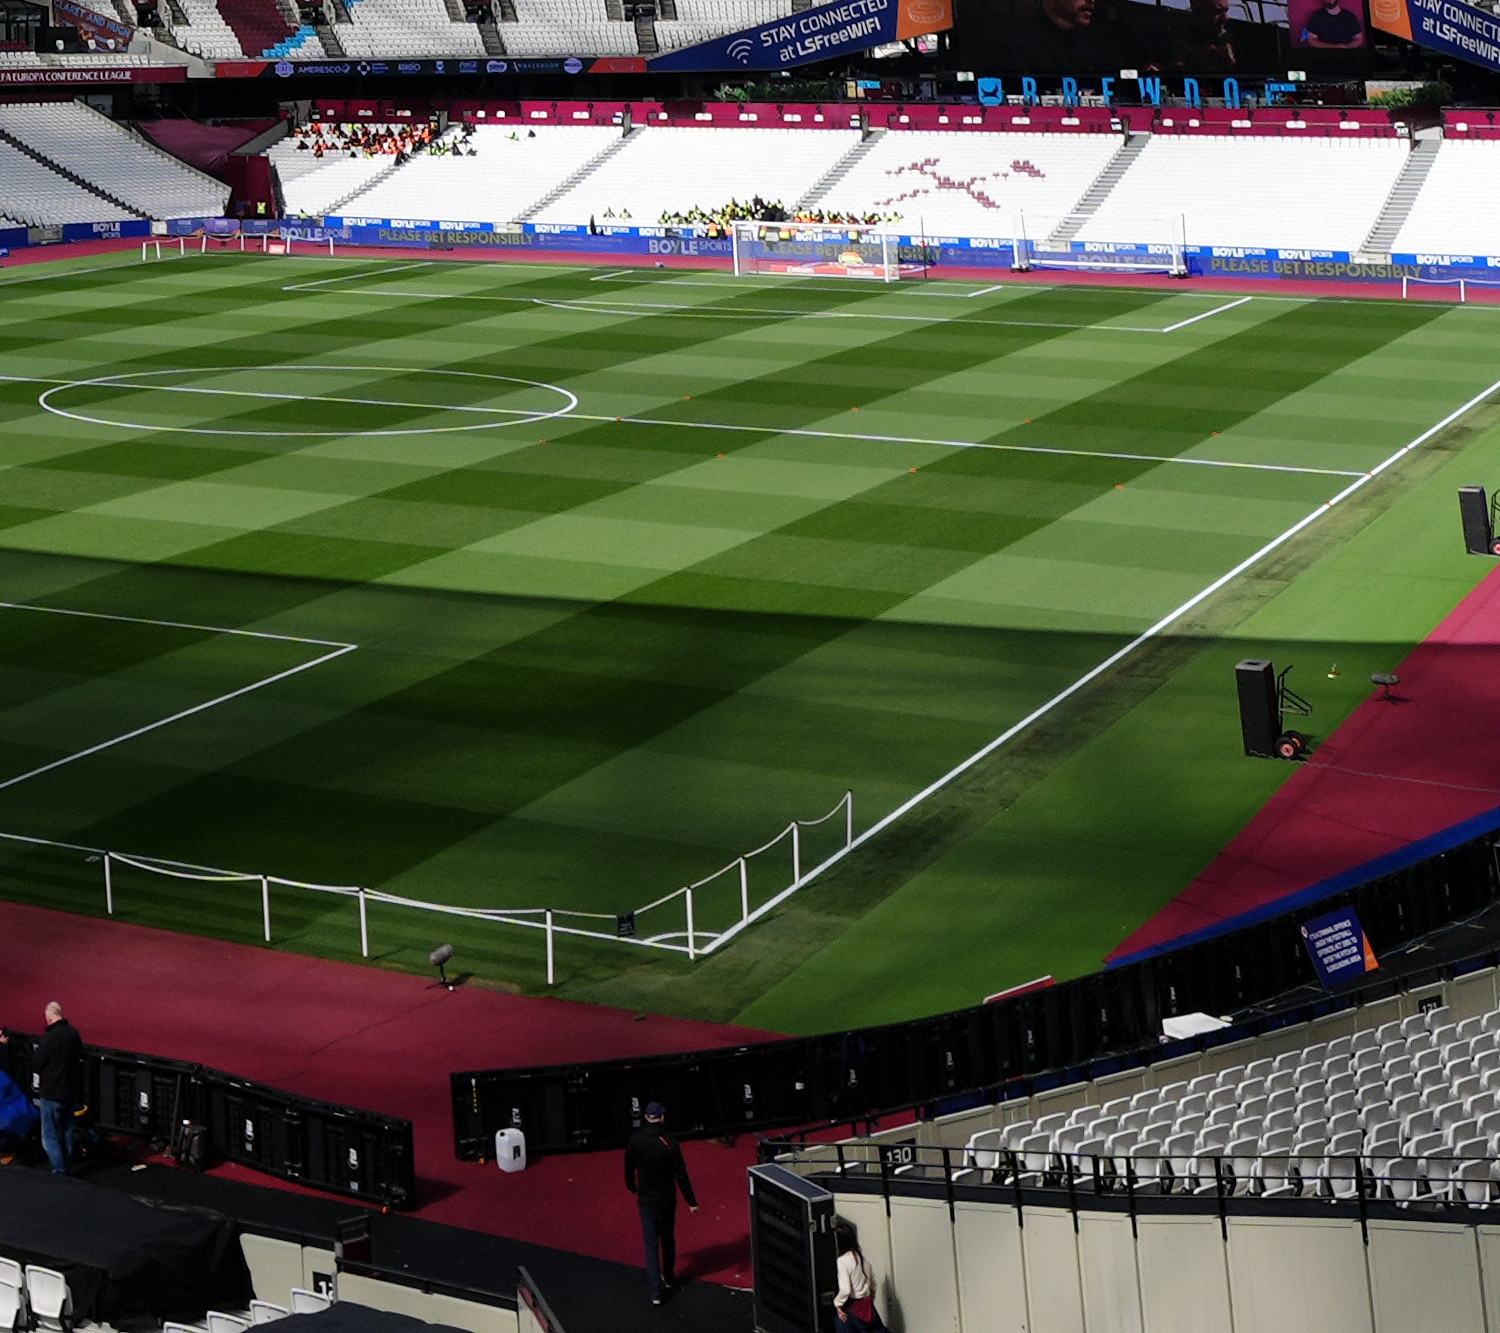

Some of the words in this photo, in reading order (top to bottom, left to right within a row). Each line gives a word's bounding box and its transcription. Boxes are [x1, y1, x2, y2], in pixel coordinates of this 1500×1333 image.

[86, 12, 106, 27] AND
[1422, 16, 1434, 33] at
[760, 22, 797, 48] STAY
[779, 44, 796, 61] at
[298, 66, 342, 74] AMERESCO
[12, 72, 45, 82] EUROPA
[45, 71, 99, 82] CONFERENCE
[99, 71, 132, 81] LEAGUE
[92, 221, 121, 232] BOYLE
[343, 217, 366, 226] BOYLE
[391, 219, 414, 228] BOYLE
[439, 220, 464, 229] BOYLE
[280, 226, 322, 240] BOYLE
[535, 224, 560, 233] BOYLE
[639, 227, 665, 237] BOYLE
[379, 229, 421, 242] PLEASE
[424, 231, 446, 244] BET
[447, 231, 534, 246] RESPONSIBLY
[649, 239, 698, 254] BOYLE
[697, 240, 732, 252] SPORTS
[1085, 242, 1115, 253] BOYLE
[1212, 247, 1245, 257] BOYLE
[1278, 249, 1311, 260] BOYLE
[1416, 254, 1450, 265] BOYLE
[1450, 255, 1474, 264] SPORTS
[1211, 259, 1268, 273] PLEASE
[1274, 261, 1300, 274] BET
[1304, 263, 1422, 280] RESPONSIBLY
[886, 1146, 912, 1165] 130
